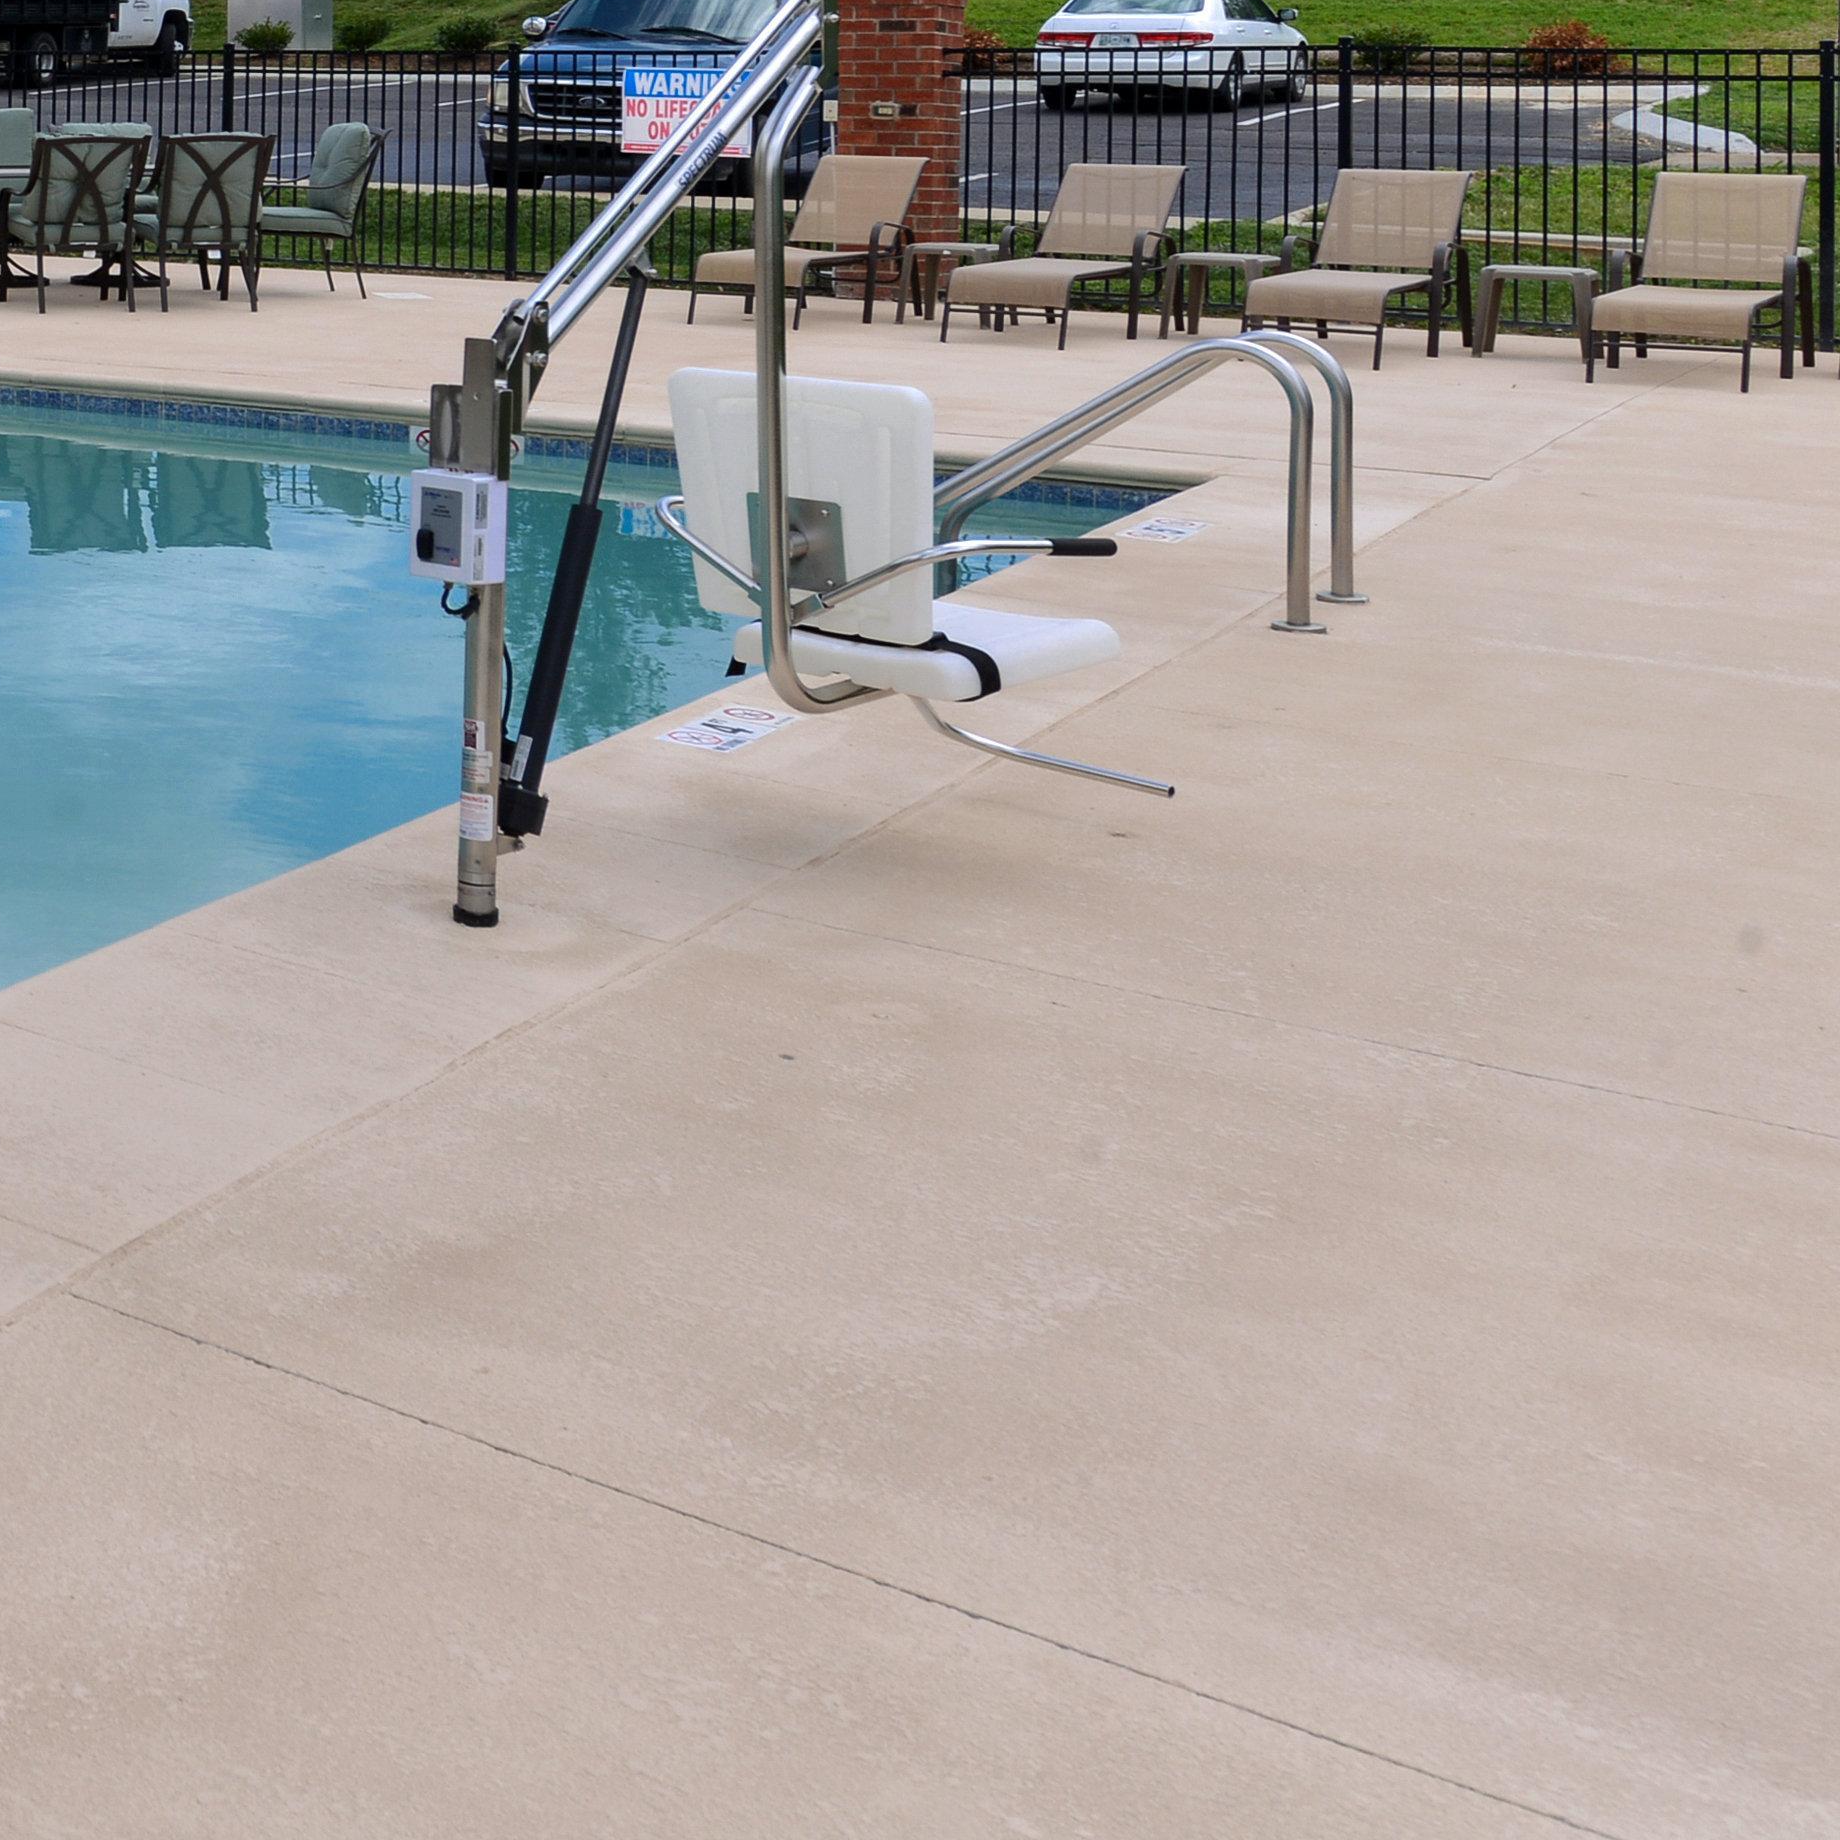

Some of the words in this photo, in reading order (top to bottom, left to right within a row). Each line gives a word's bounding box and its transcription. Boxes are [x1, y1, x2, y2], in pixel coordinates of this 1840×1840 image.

[626, 98, 647, 118] NO
[648, 121, 670, 140] ON
[678, 131, 727, 188] SPECTRUM
